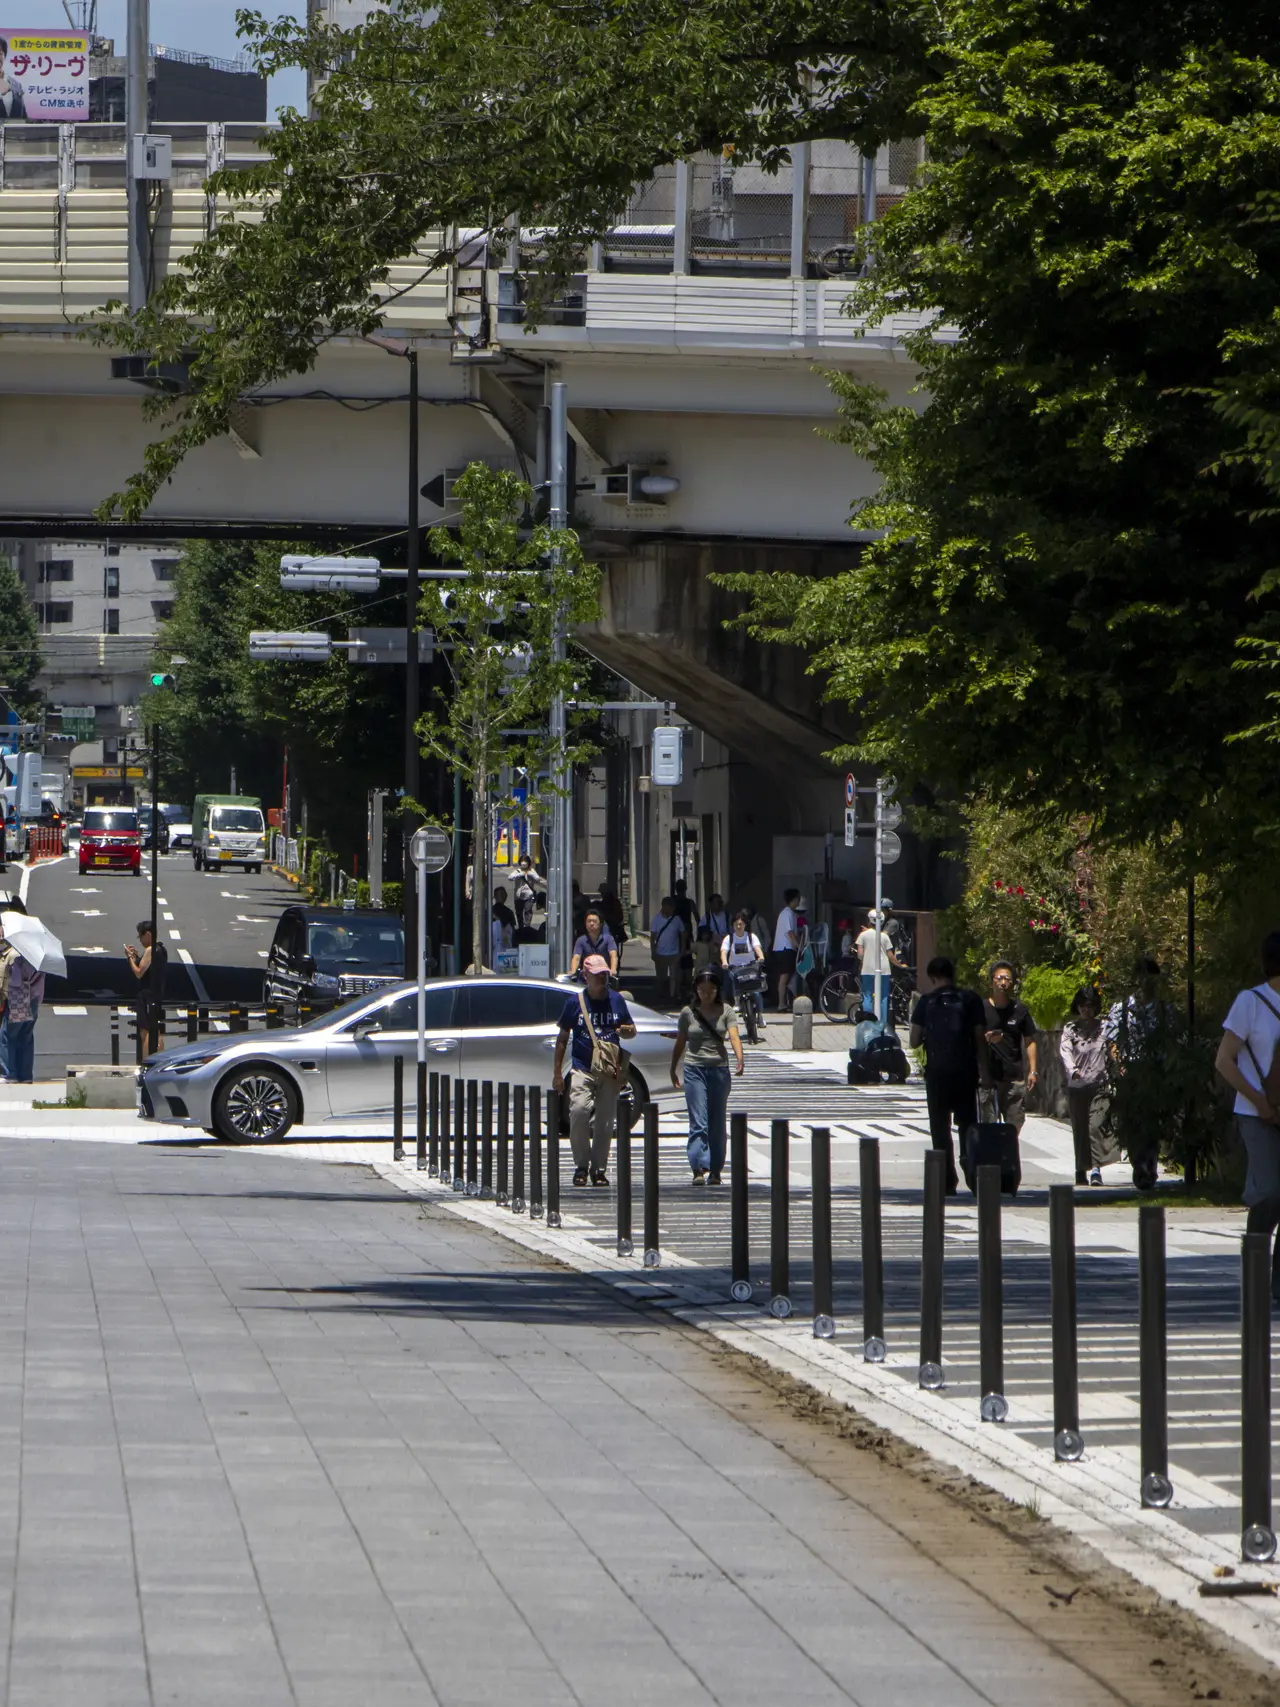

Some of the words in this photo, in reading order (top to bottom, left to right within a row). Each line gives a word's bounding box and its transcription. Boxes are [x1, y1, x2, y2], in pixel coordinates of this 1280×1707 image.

[28, 85, 85, 95] テレビ・ラジオ
[40, 98, 85, 109] CM放送中
